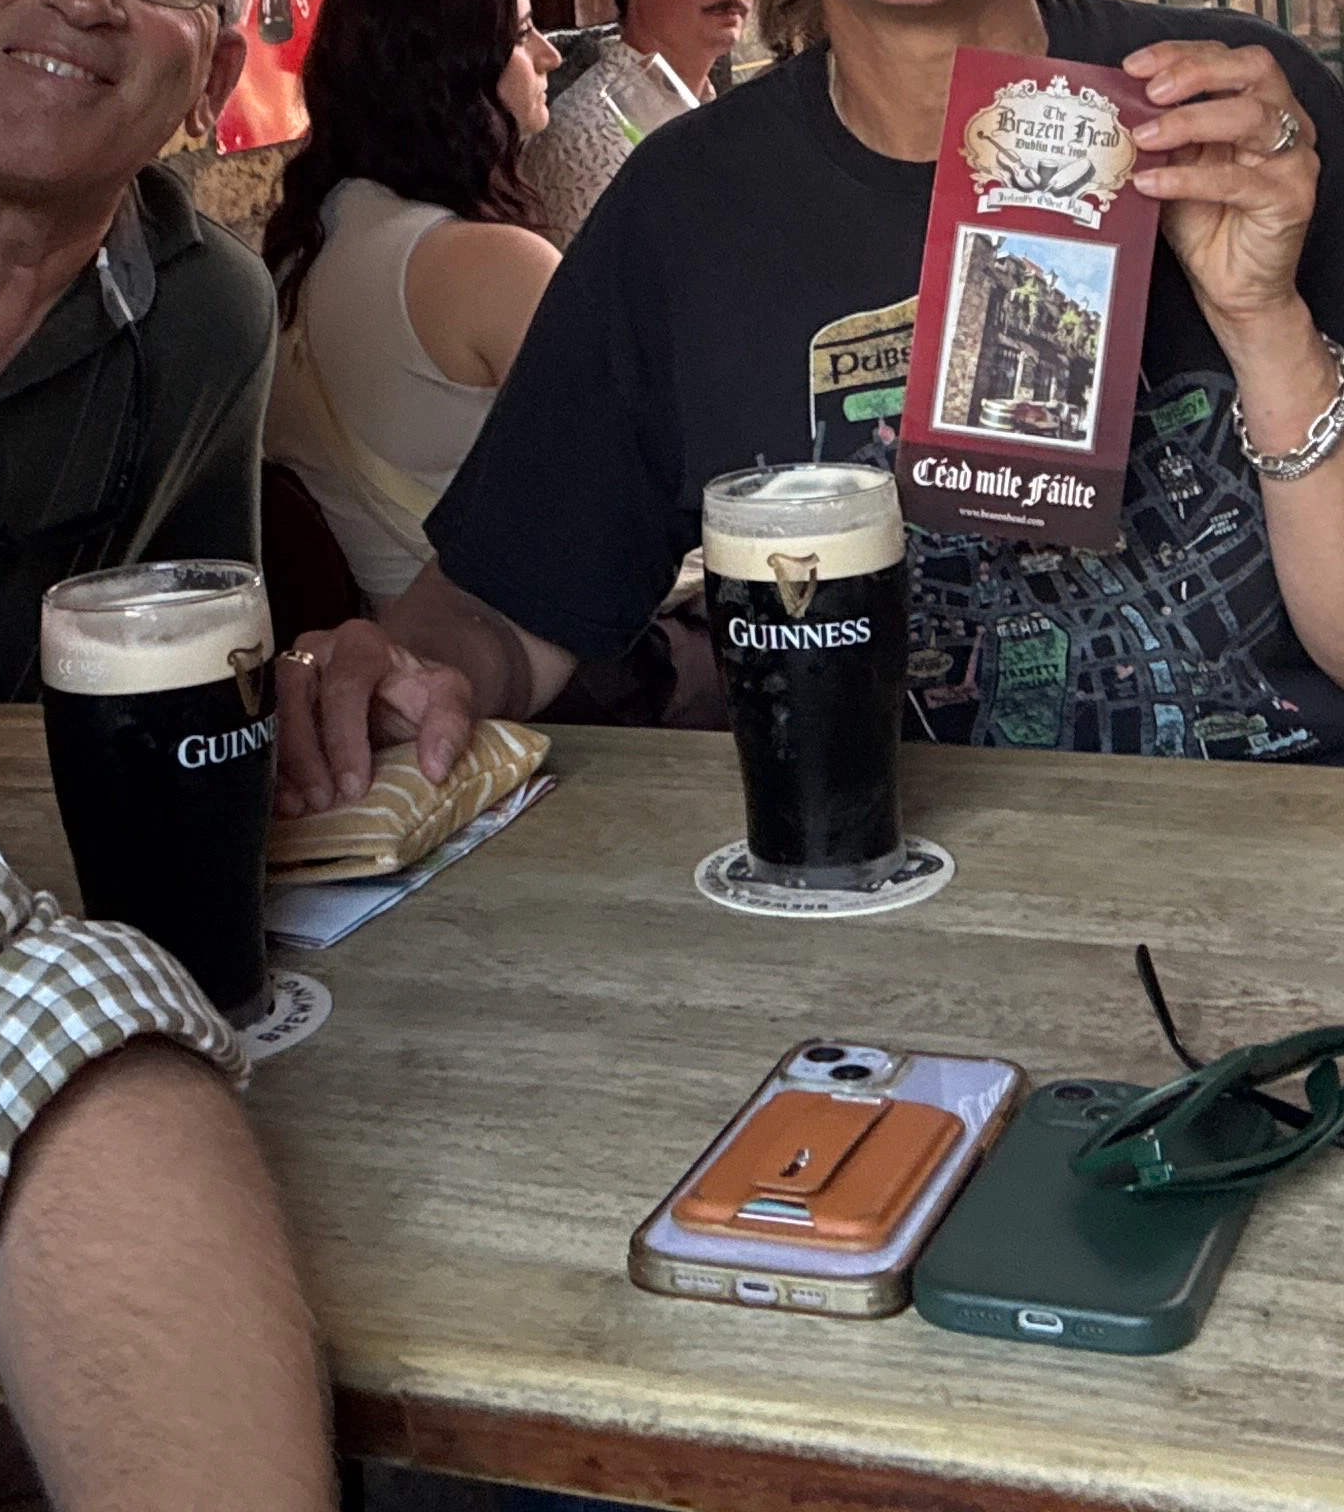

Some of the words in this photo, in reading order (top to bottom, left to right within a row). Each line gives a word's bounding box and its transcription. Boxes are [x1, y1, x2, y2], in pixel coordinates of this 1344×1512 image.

[991, 105, 1065, 141] Brazen
[1067, 115, 1121, 149] Head
[1042, 103, 1068, 121] The
[1014, 138, 1048, 154] Dublin
[912, 456, 973, 492] Céad
[975, 466, 1023, 500] míle
[1020, 472, 1097, 510] Fáilte
[728, 617, 872, 650] GUINNESS
